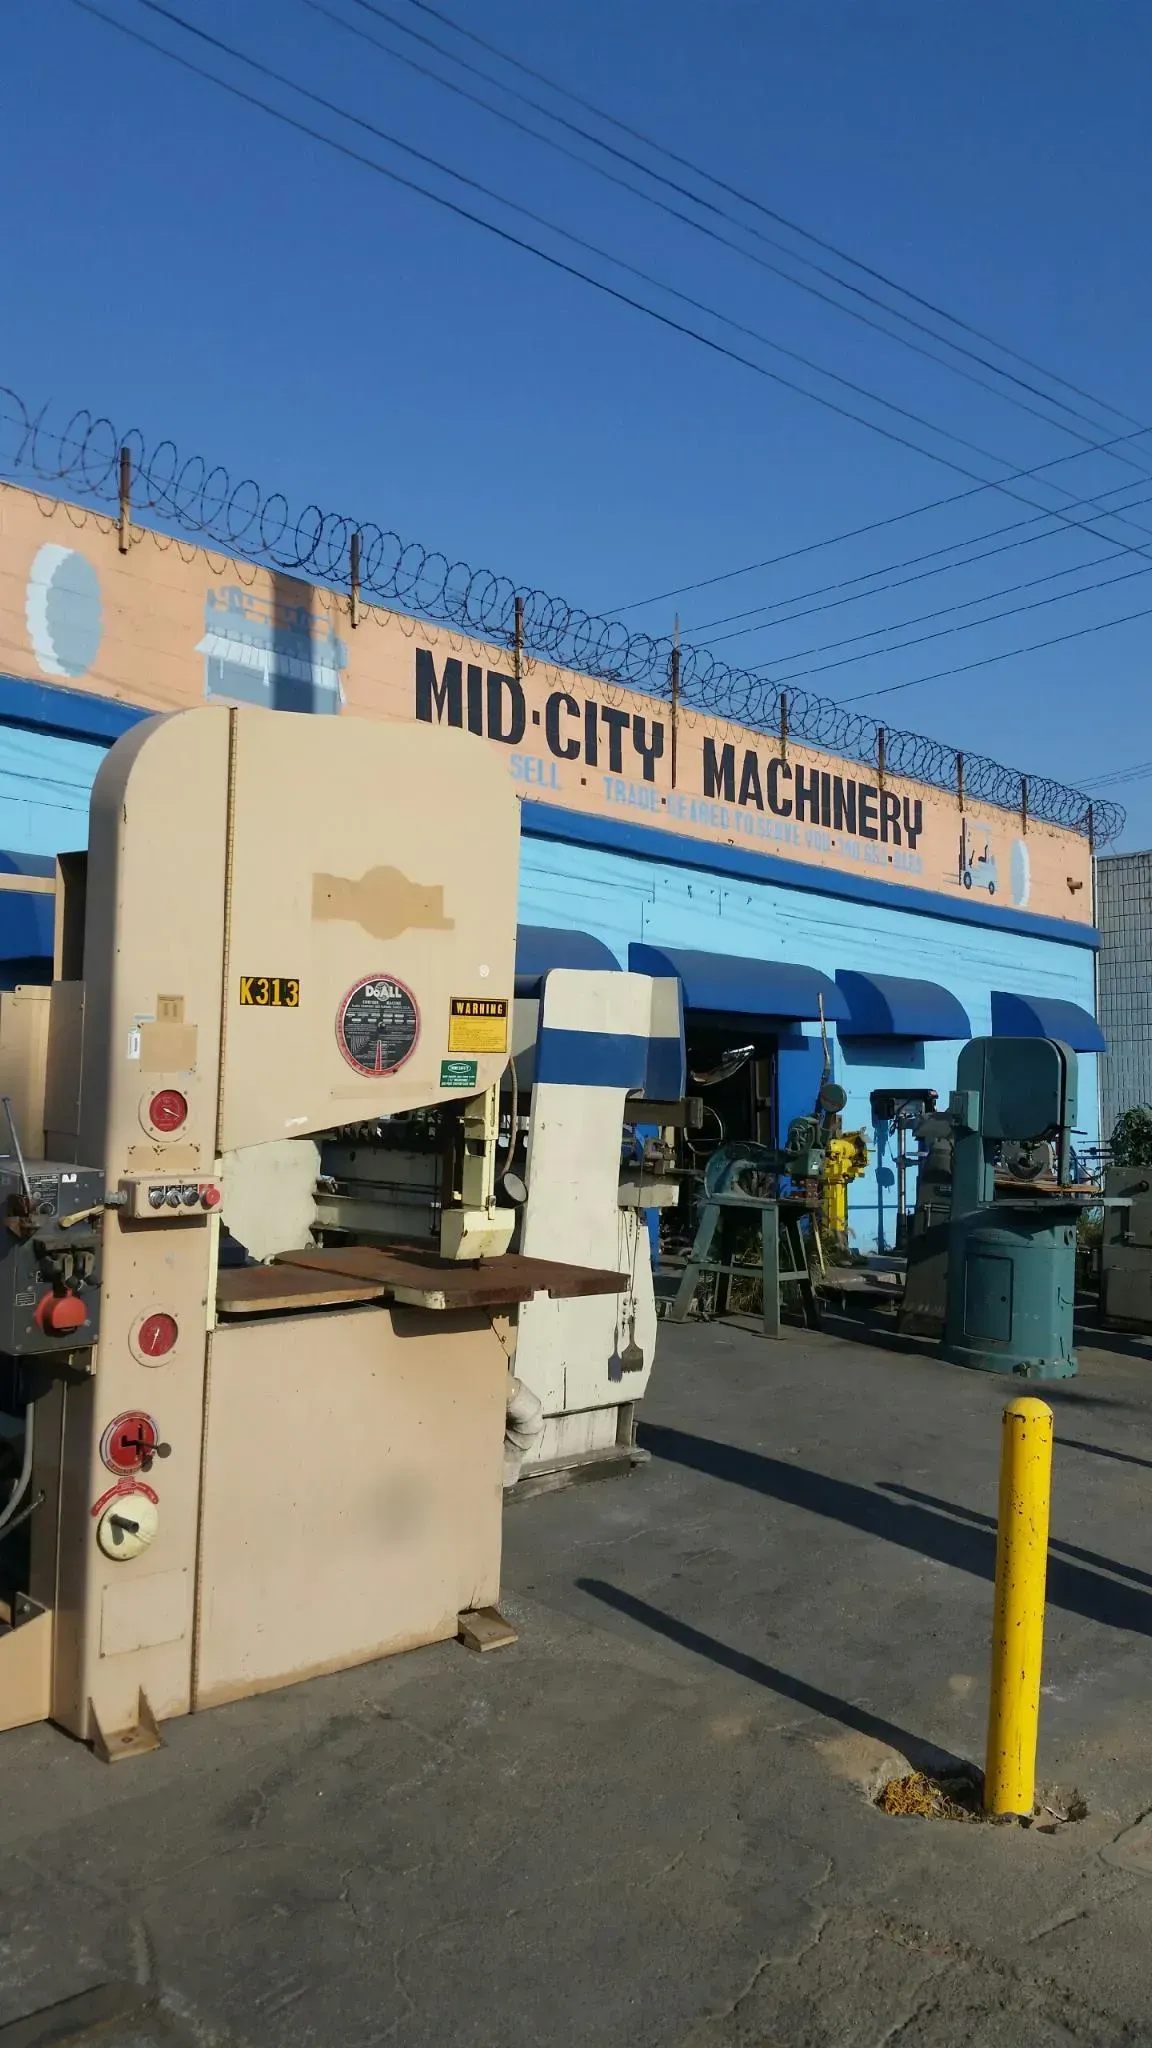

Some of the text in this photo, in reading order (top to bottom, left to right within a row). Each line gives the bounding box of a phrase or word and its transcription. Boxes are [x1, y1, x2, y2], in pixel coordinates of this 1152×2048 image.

[510, 753, 561, 791] SELL
[703, 736, 922, 850] MACHINERY
[240, 977, 298, 1006] K313
[456, 1002, 503, 1015] WARNING
